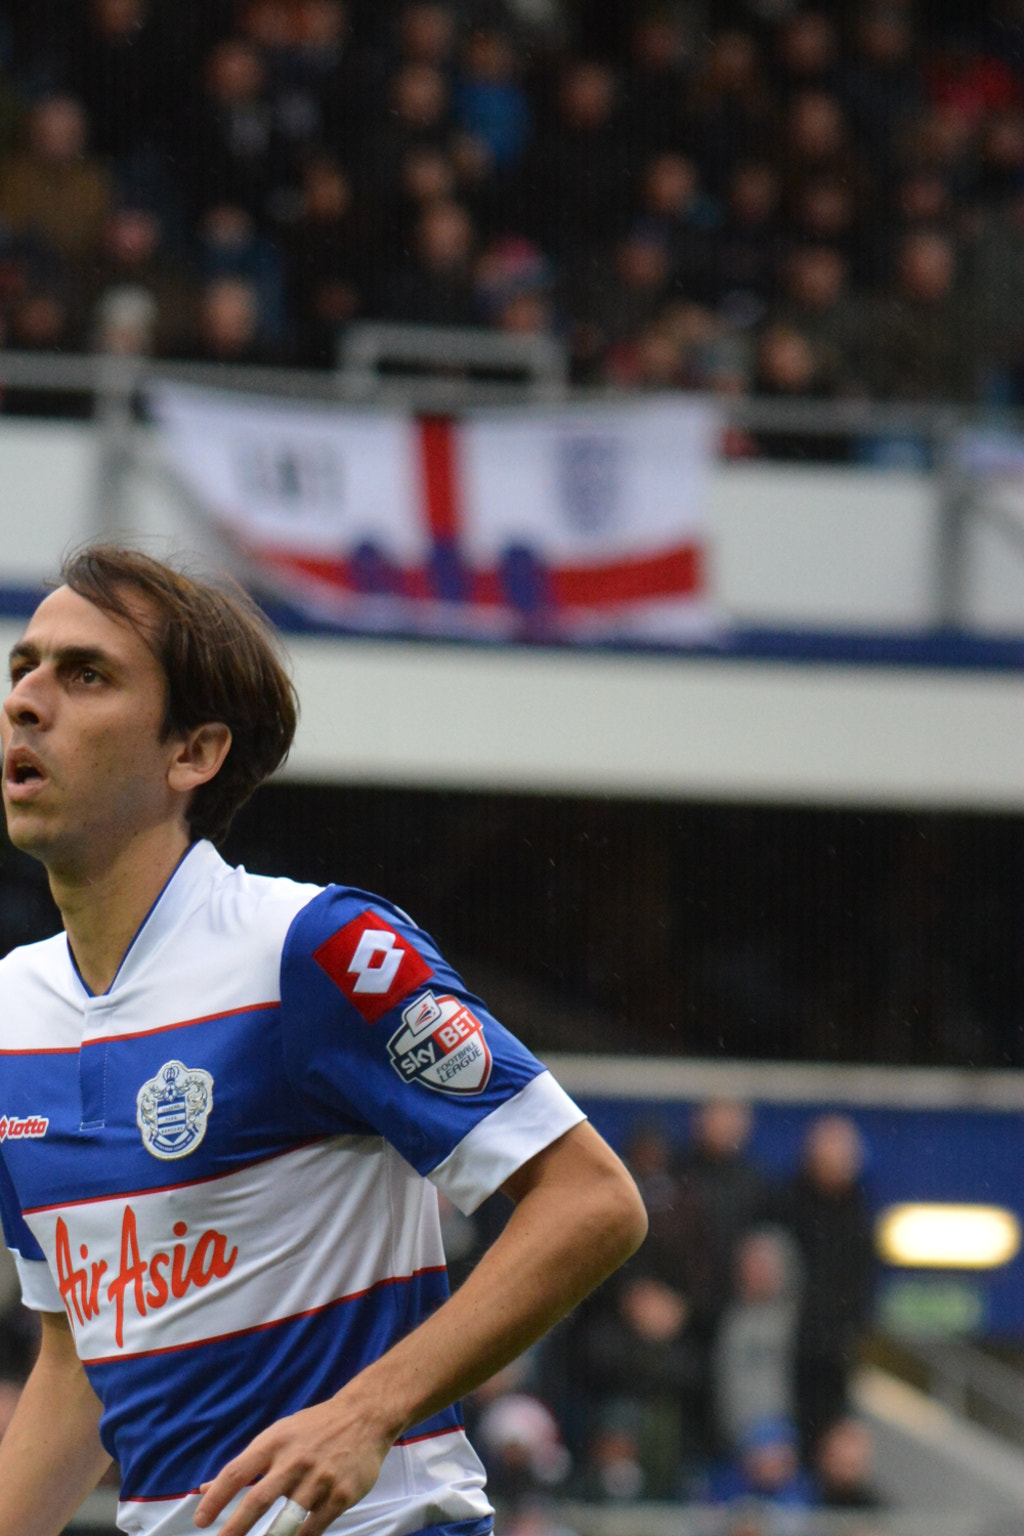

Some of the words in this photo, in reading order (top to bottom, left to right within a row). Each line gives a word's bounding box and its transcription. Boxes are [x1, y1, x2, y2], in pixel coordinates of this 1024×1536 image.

[438, 1011, 476, 1049] BET
[436, 1042, 478, 1075] FOOTBALL
[439, 1047, 482, 1083] LEAGUE
[8, 1118, 47, 1137] lotto
